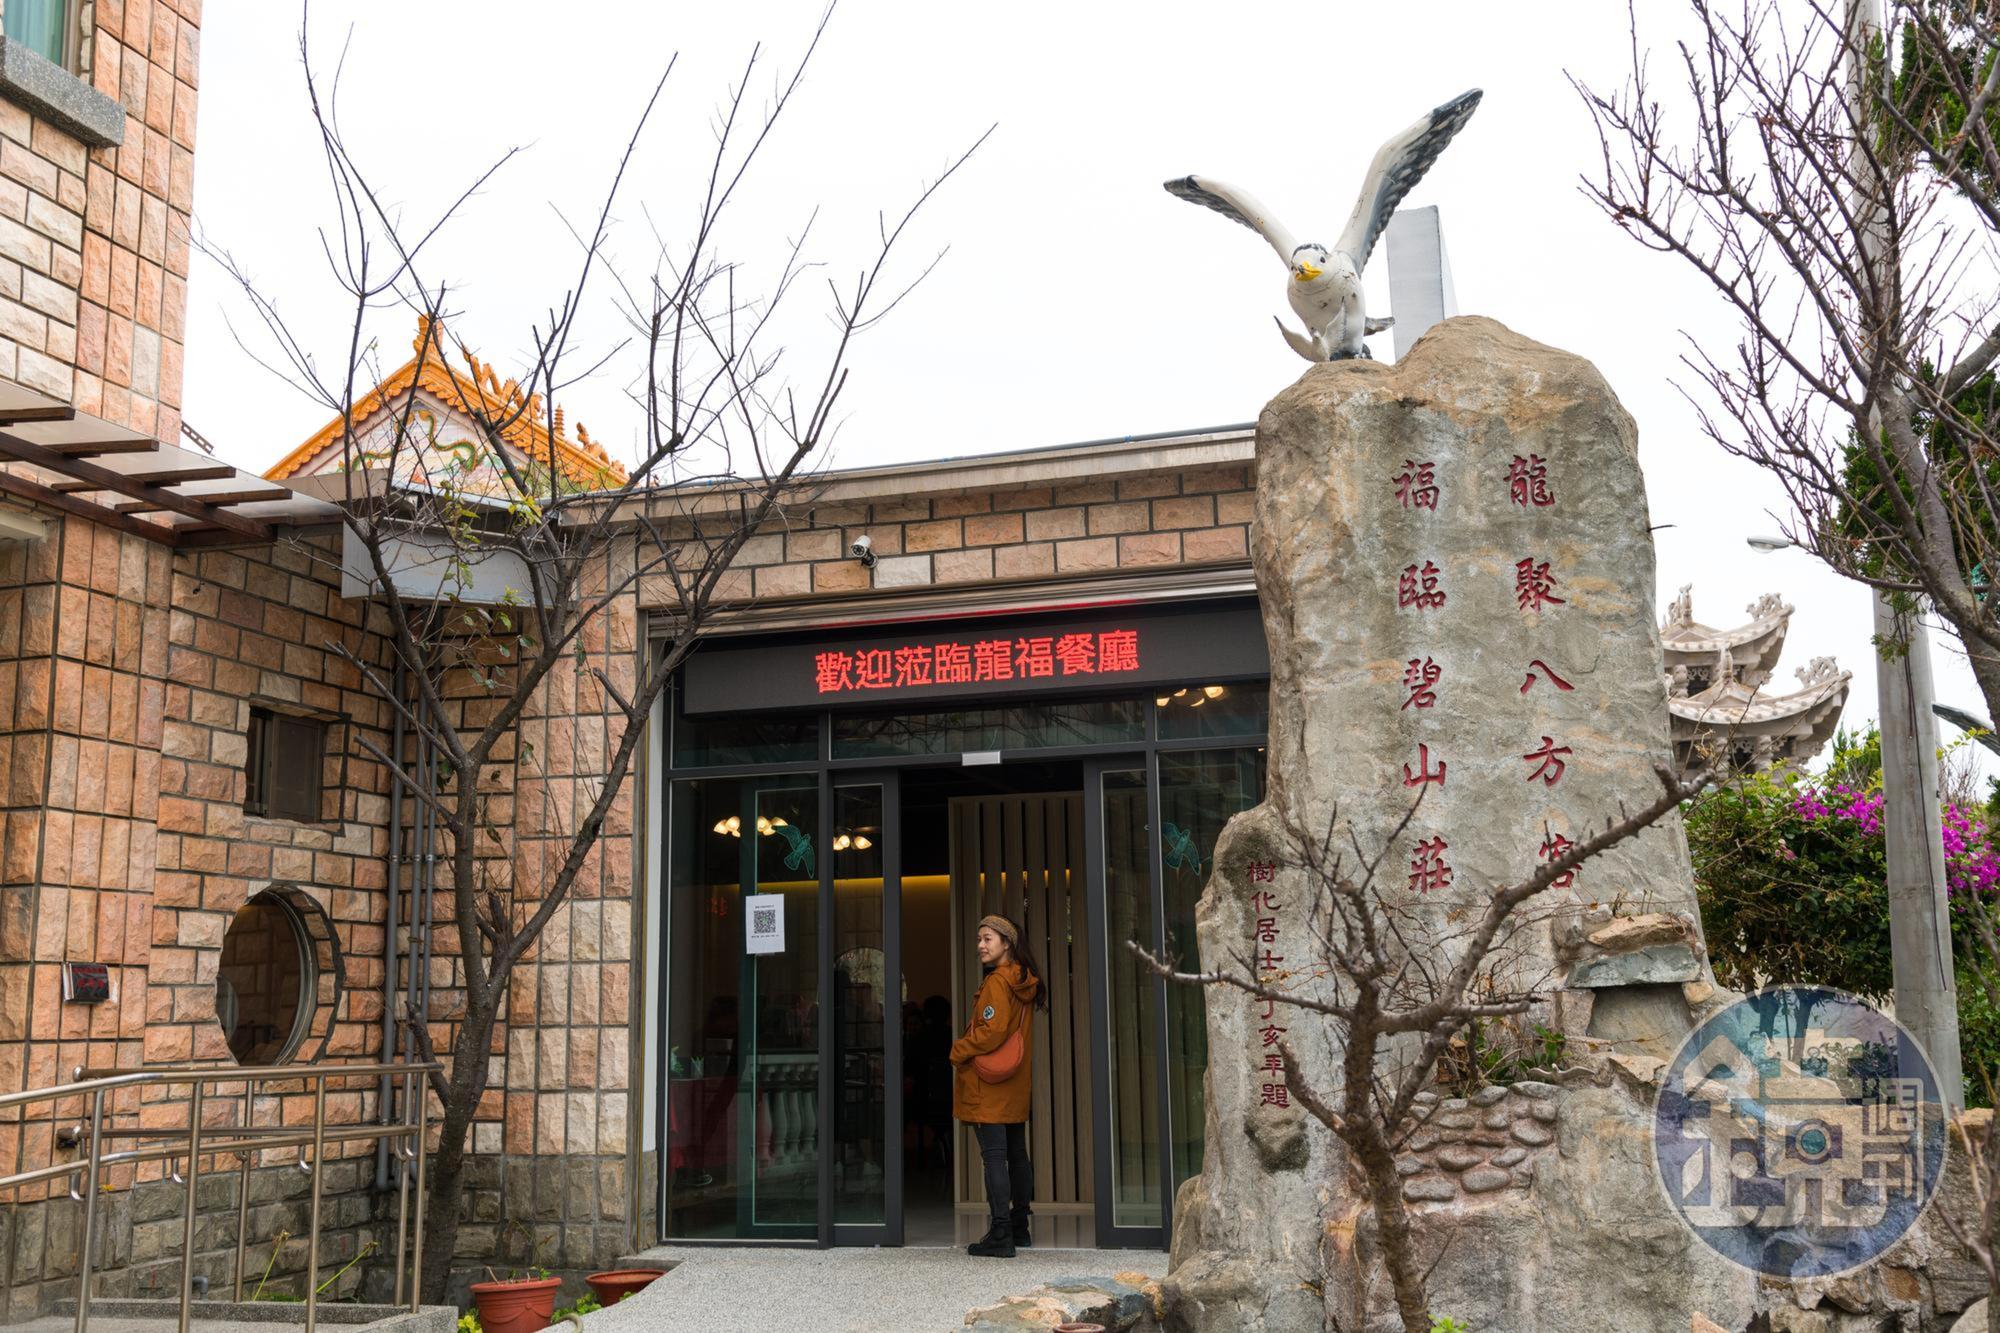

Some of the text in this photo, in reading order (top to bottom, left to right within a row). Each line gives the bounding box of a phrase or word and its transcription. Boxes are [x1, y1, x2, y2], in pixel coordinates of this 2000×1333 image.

[815, 629, 1139, 693] 歡迎蒞臨龍福餐廳
[1392, 459, 1454, 895] 福臨碧山莊
[1502, 454, 1583, 889] 龍聚八方客
